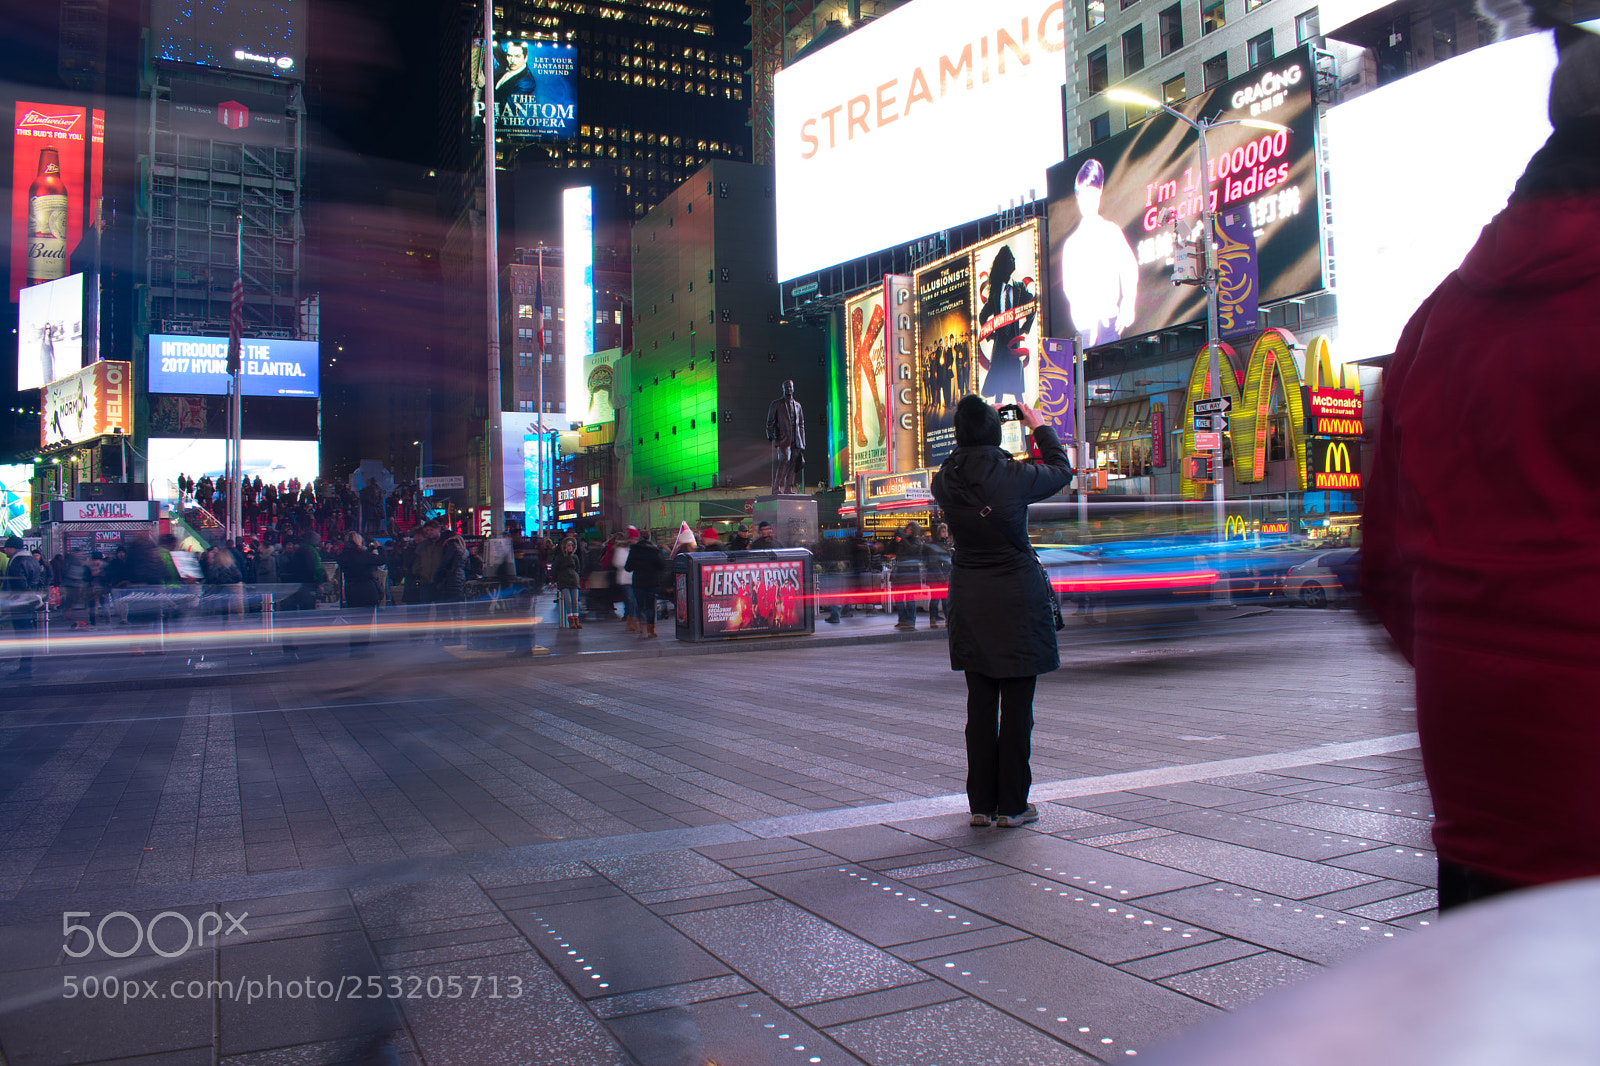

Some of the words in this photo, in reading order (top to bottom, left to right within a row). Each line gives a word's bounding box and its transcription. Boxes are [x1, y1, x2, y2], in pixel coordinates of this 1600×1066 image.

[801, 0, 1064, 160] STREAMING
[511, 94, 537, 103] THE
[25, 113, 74, 126] Budweiser
[500, 117, 525, 126] THE
[526, 118, 566, 128] OPERA
[16, 128, 32, 136] THIS
[32, 130, 53, 138] BUD'S
[1143, 188, 1218, 231] Gacing
[1224, 162, 1289, 203] ladies
[1144, 178, 1177, 208] I'm
[940, 268, 950, 277] THE
[1214, 212, 1250, 330] Aladdin
[920, 267, 970, 295] ILLUSIONISTS
[994, 310, 1014, 330] MONTHS
[162, 342, 245, 358] INTRODUCIG
[248, 346, 270, 360] THE
[898, 288, 913, 430] PALACE
[161, 358, 189, 373] 2017
[191, 359, 244, 374] HYUNI
[248, 361, 306, 377] ELANTRA.
[1038, 338, 1069, 426] Aladdi
[60, 395, 87, 418] MORMN
[106, 364, 122, 434] HELLO!
[1312, 396, 1362, 409] McDonald's
[1321, 407, 1354, 415] Restaurant
[876, 481, 922, 495] ILLUSIONISTS
[86, 503, 127, 516] S'WICH
[704, 570, 760, 596] JERSEY
[764, 568, 800, 591] BOYS
